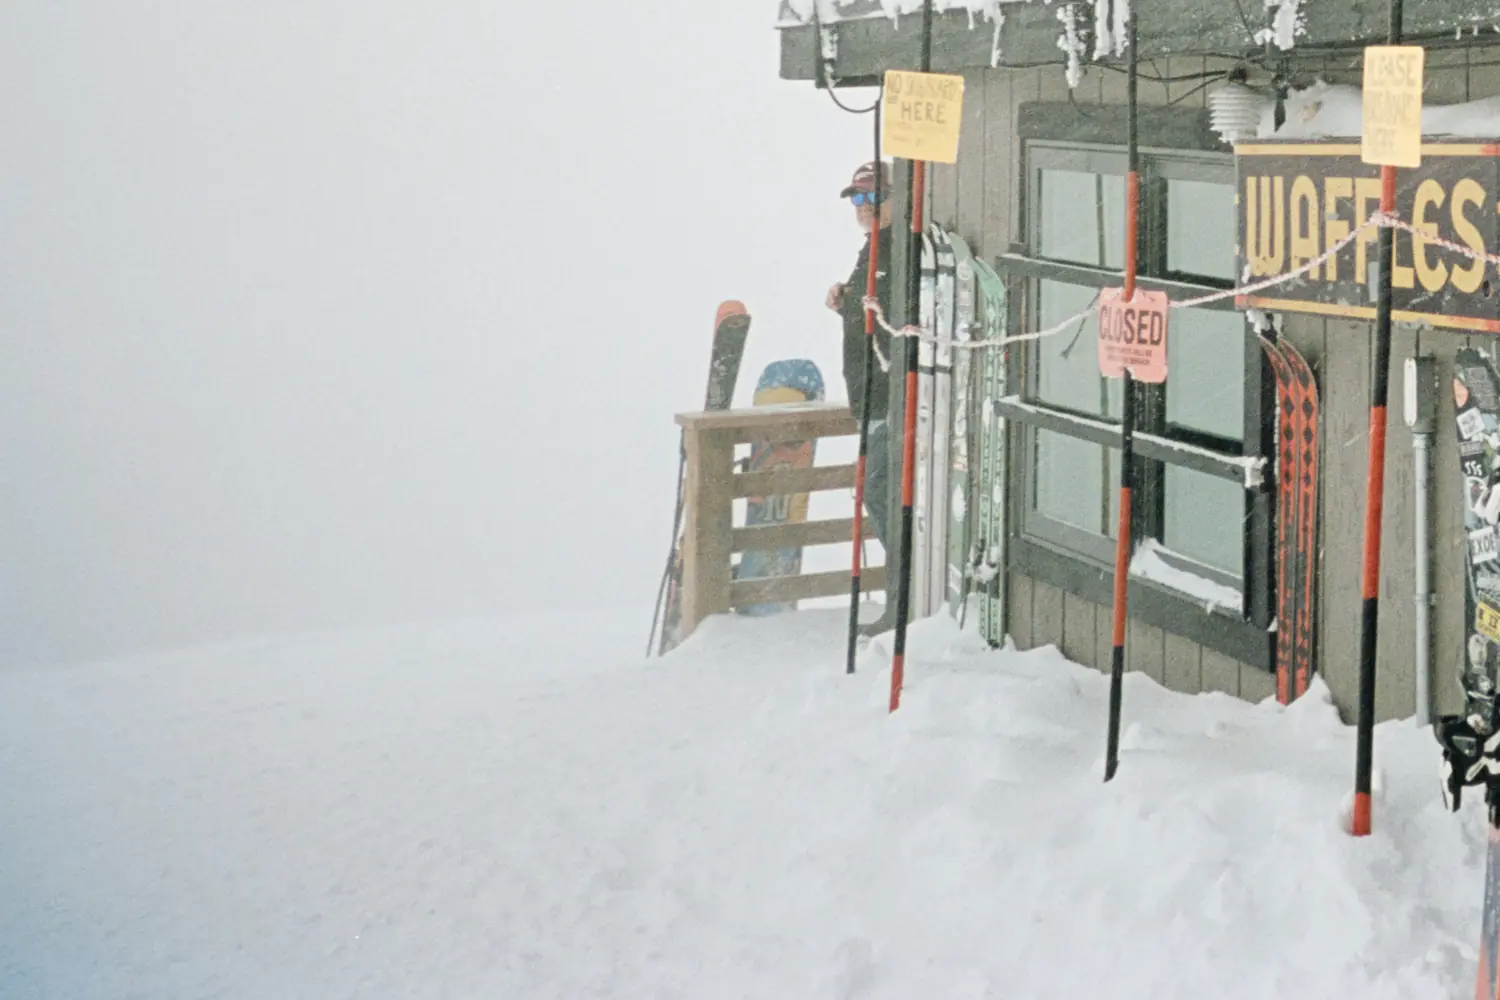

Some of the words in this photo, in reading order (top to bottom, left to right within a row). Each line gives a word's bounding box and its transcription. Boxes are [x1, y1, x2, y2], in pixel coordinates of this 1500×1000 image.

[901, 101, 946, 124] HERE
[1246, 174, 1486, 294] WAFFLES
[1099, 305, 1164, 346] CLOSED
